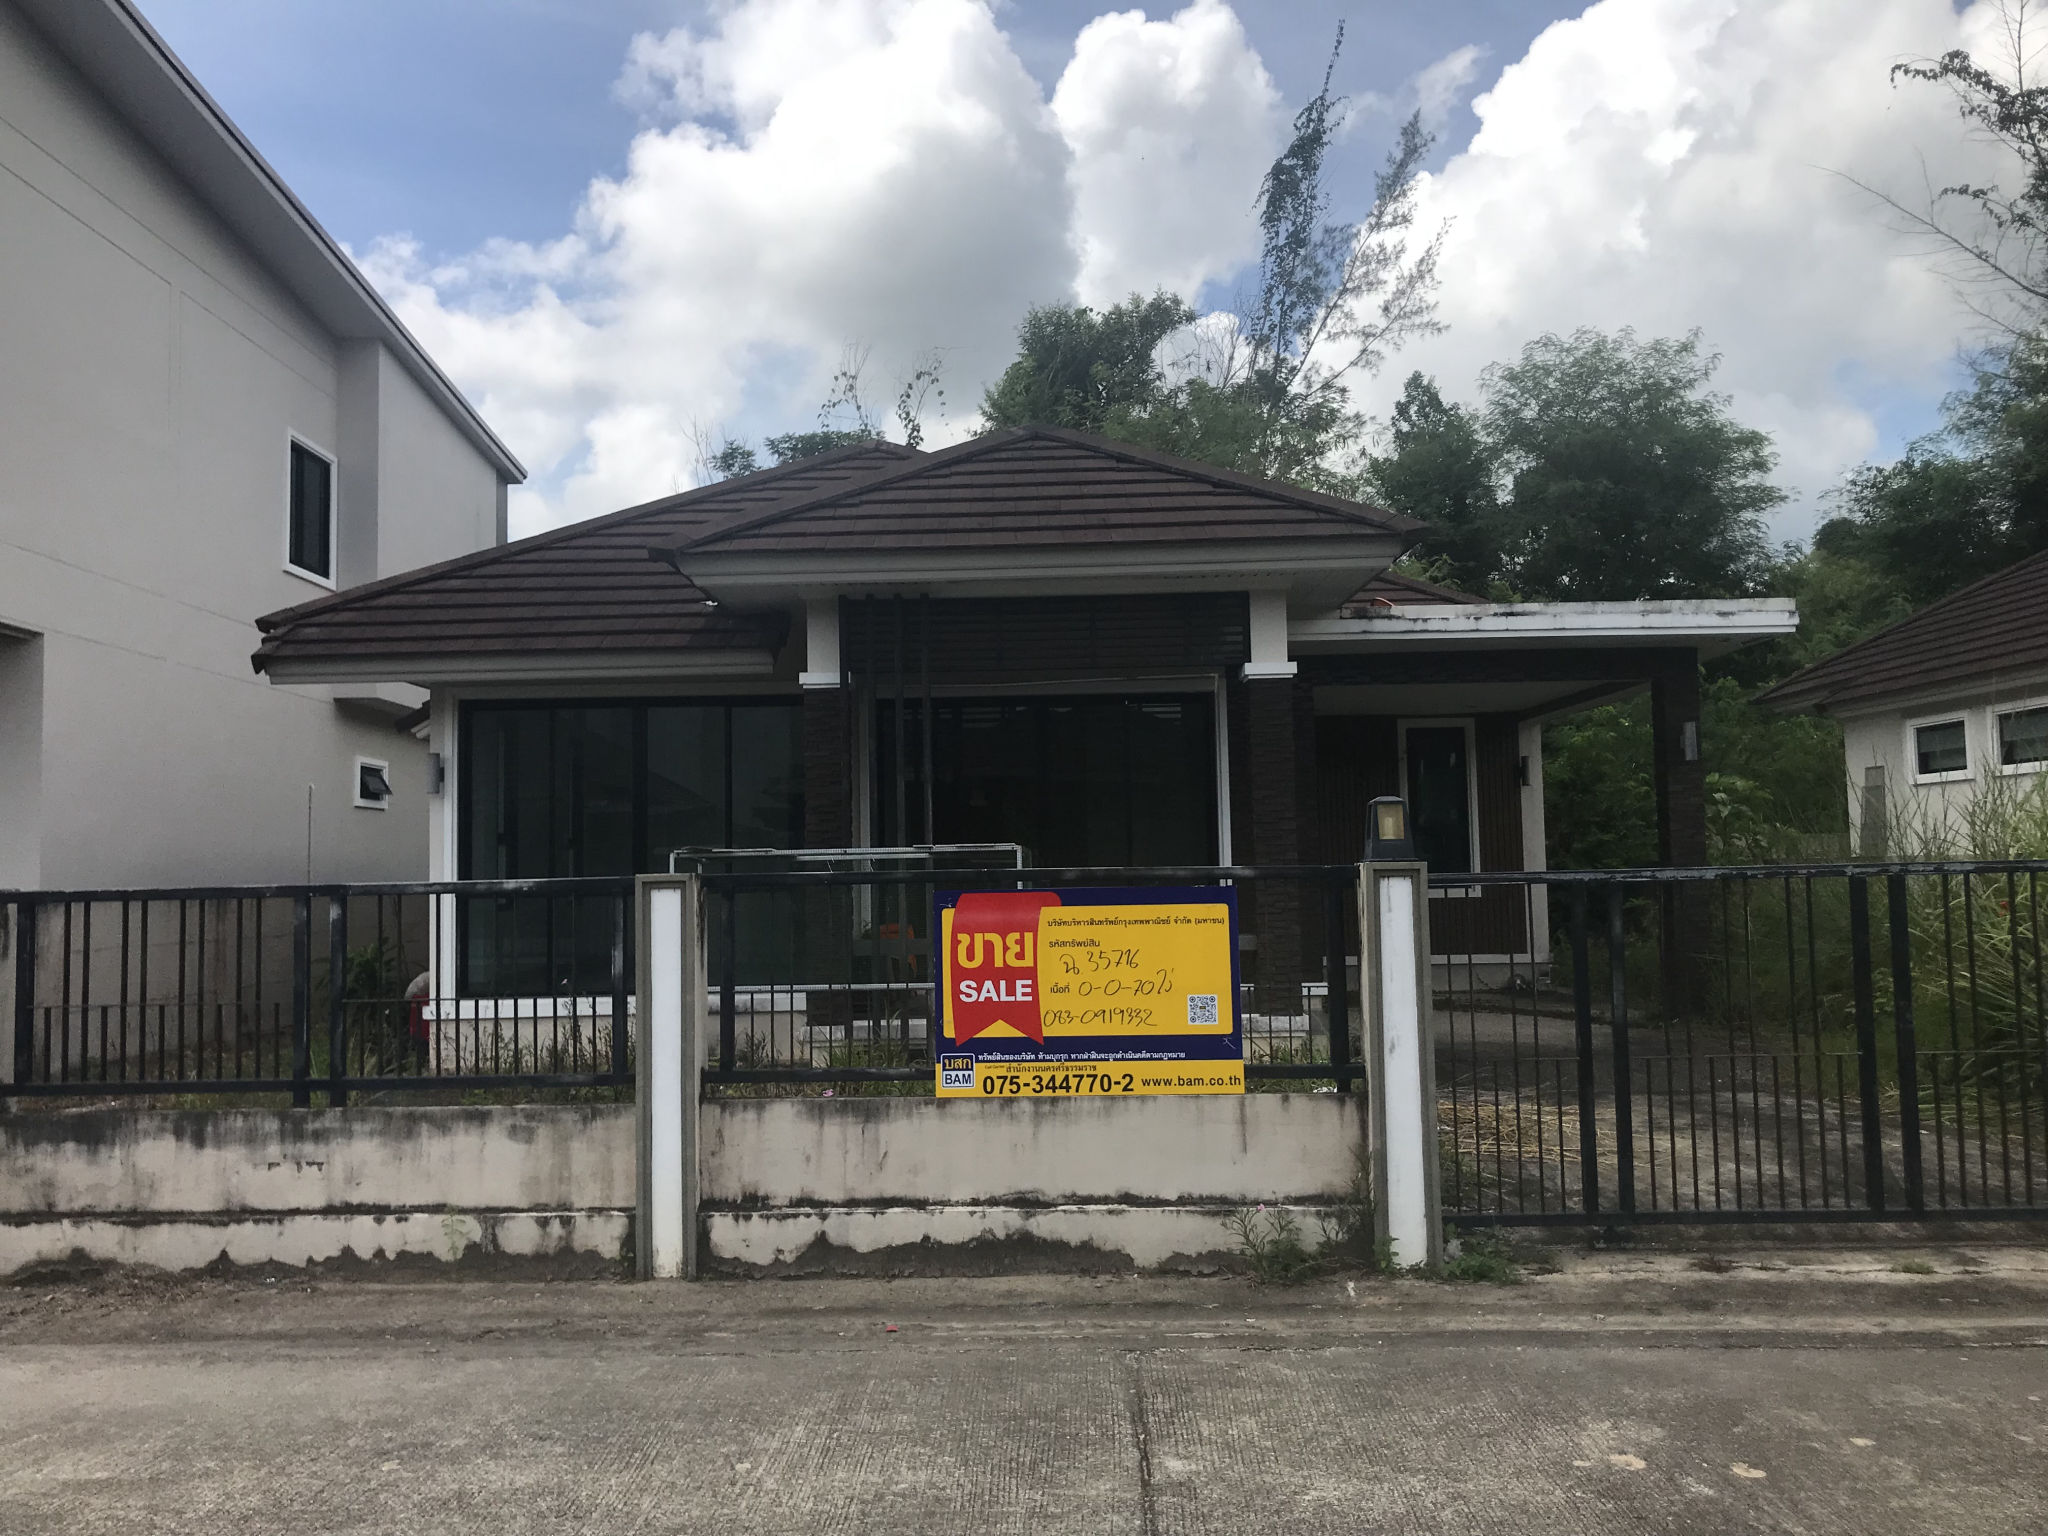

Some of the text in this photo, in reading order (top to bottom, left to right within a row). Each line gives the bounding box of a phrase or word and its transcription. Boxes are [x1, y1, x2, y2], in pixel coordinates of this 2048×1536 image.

[1047, 916, 1225, 927] บริษัทบริหารสินทรัพย์กรุงเทพพาณิชย์ จำกัด (มหาชน)
[1049, 938, 1101, 948] รหัสทรัพย์สิน
[957, 932, 1034, 969] ขาย
[959, 979, 1033, 1003] SALE
[1050, 982, 1070, 994] เนื้อที่
[978, 1052, 1036, 1061] ทรัพย์สินของบริษัท
[1038, 1052, 1069, 1062] ห้ามบุกรุก
[944, 1057, 972, 1070] บสก
[1006, 1063, 1097, 1073] สำนักงานนครศรีธรรมราช
[944, 1073, 972, 1085] BAM
[983, 1074, 1241, 1094] 075-344770-2 www.bam.co.th
